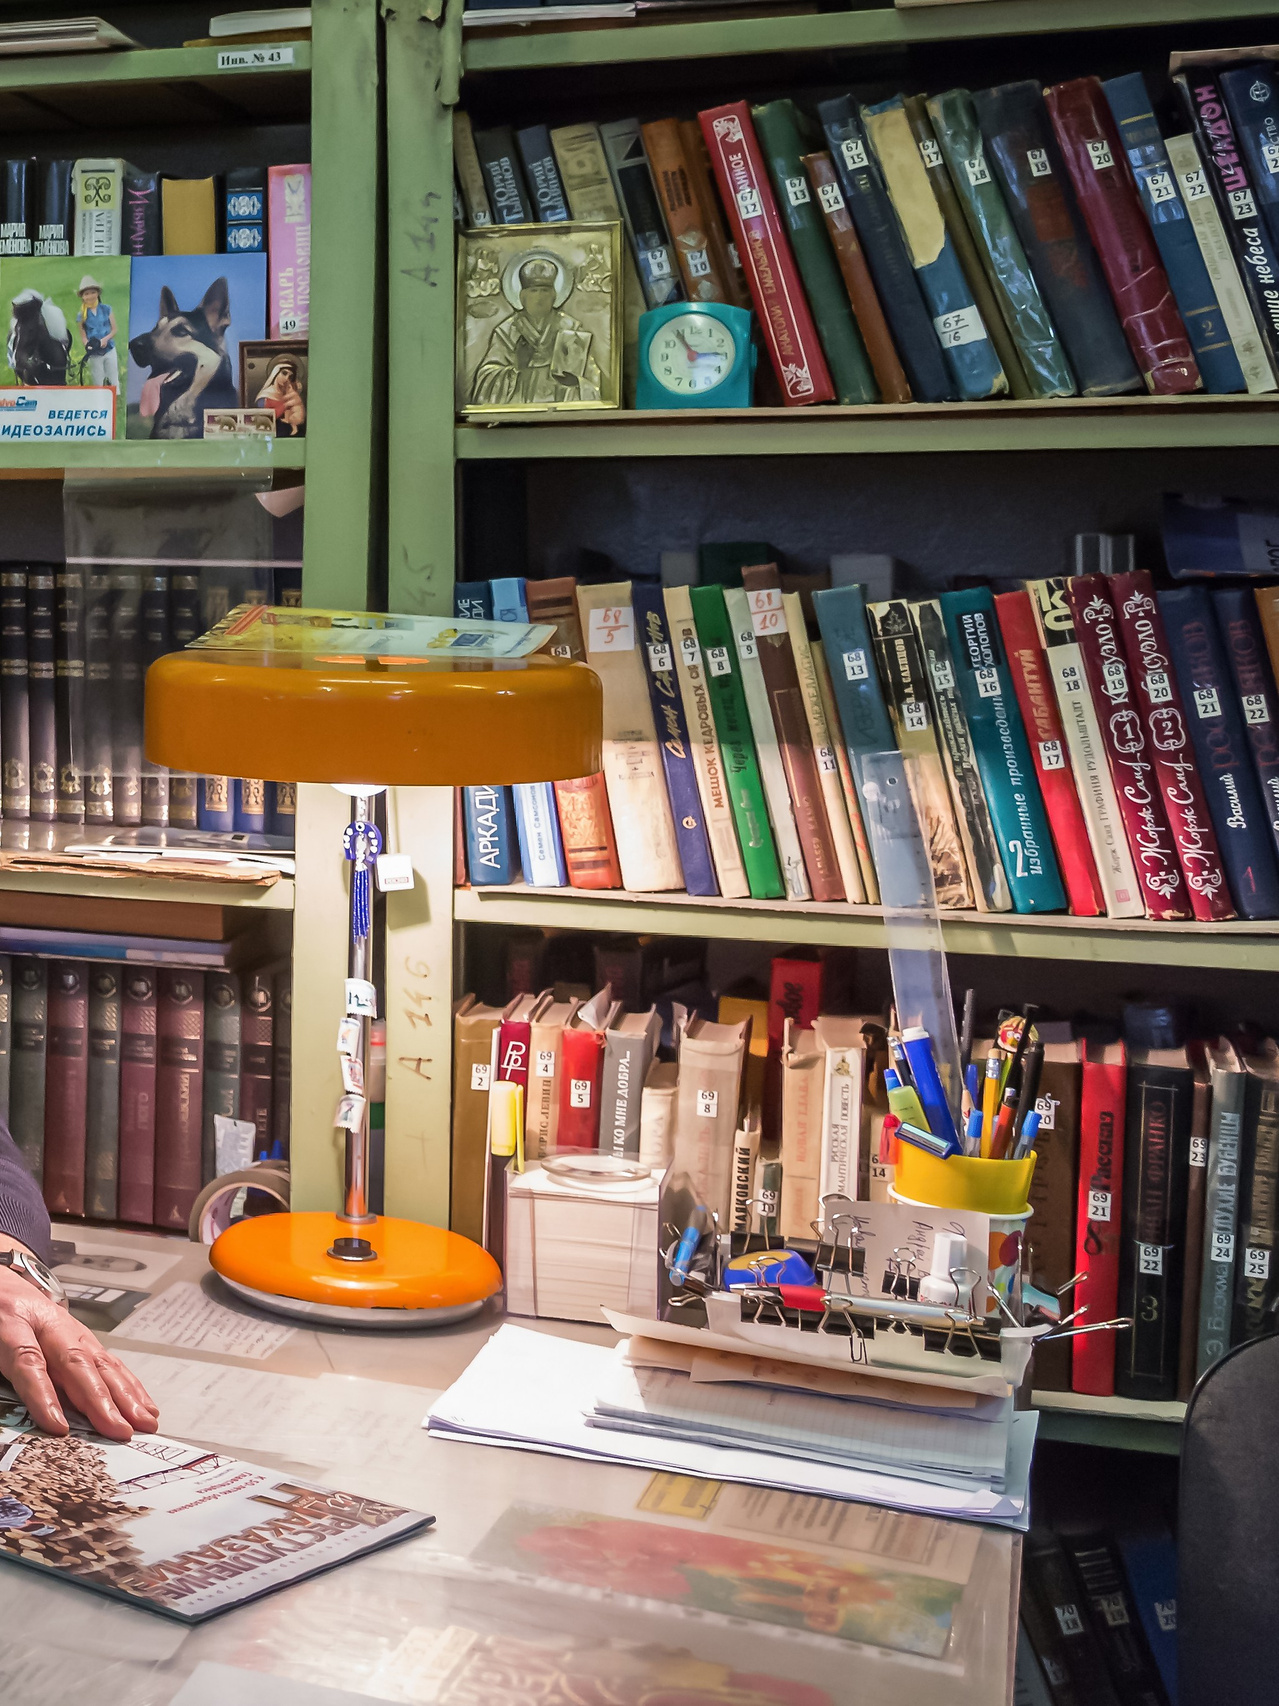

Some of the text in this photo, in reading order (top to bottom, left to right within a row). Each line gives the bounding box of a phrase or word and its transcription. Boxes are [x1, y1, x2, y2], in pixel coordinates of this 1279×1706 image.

[221, 51, 281, 66] Инв. 43
[1195, 85, 1247, 191] ШЕЛДОН
[845, 142, 860, 152] 67
[922, 140, 936, 150] 67
[1091, 142, 1105, 152] 67
[850, 154, 864, 164] 15
[926, 152, 939, 162] 17
[1030, 150, 1044, 160] 67
[1096, 154, 1111, 164] 20
[1035, 162, 1048, 172] 19
[789, 178, 802, 188] 67
[1151, 175, 1165, 185] 67
[1186, 172, 1200, 183] 67
[486, 161, 503, 208] Юрий
[529, 161, 549, 209] Юрий
[822, 185, 836, 195] 67
[1190, 185, 1205, 195] 22
[741, 190, 754, 201] 67
[794, 190, 807, 200] 13
[1156, 187, 1170, 198] 21
[1233, 192, 1247, 202] 67
[826, 197, 840, 207] 14
[744, 204, 757, 214] 12
[1238, 204, 1253, 214] 23
[0, 224, 26, 238] МАРИЯ
[39, 224, 64, 239] МАРИЯ
[1244, 228, 1274, 283] небеса
[750, 230, 776, 294] ЕМЕЛЬЯНОВ
[942, 315, 964, 327] 67
[948, 331, 961, 343] 16
[48, 410, 108, 421] ВЕДЕТСЯ
[602, 609, 622, 624] 68
[759, 613, 778, 630] 10
[604, 629, 614, 643] 5
[740, 632, 755, 642] 68
[974, 613, 993, 667] ХОЛОПОВ
[683, 639, 697, 649] 68
[962, 615, 979, 669] ГЕОРГИЙ
[653, 645, 667, 655] 68
[711, 649, 725, 659] 68
[847, 653, 862, 662] 68
[980, 670, 994, 679] 68
[1062, 668, 1076, 677] 68
[1108, 666, 1121, 675] 68
[1150, 675, 1165, 685] 68
[1020, 649, 1048, 738] САБАНТУЙ
[1198, 690, 1213, 700] 68
[1246, 696, 1262, 705] 68
[907, 704, 921, 714] 68
[694, 685, 724, 810] МЕШОК КЕДРОВЫХ
[1043, 742, 1058, 751] 68
[1072, 700, 1122, 874] Жорж Санд ГРАФИНЯ РУДОЛЬШТАДТ
[1219, 773, 1246, 829] Василий
[1124, 754, 1169, 865] Жорж Санд
[1168, 754, 1212, 867] Жорж Санд
[1016, 792, 1042, 875] избранные
[1009, 840, 1028, 877] 2
[540, 1052, 552, 1061] 69
[575, 1081, 587, 1091] 69
[702, 1091, 714, 1100] 69
[842, 1084, 850, 1121] ПОВЕСТЬ
[616, 1097, 628, 1121] МНЕ
[538, 1079, 552, 1158] БОРИС ЛЕВИН
[796, 1078, 810, 1162] НОВАЯ ГЛАВА
[614, 1123, 625, 1143] КО
[830, 1123, 838, 1163] РУССКАЯ
[1148, 1101, 1165, 1181] ФРАНКО
[1192, 1138, 1206, 1149] 69
[1218, 1112, 1240, 1175] БУБЕНЦЫ
[734, 1147, 751, 1231] МАЯКОВСКИЙ
[1093, 1193, 1107, 1204] 69
[1216, 1234, 1231, 1245] 69
[1144, 1247, 1159, 1258] 69
[1251, 1251, 1265, 1262] 69
